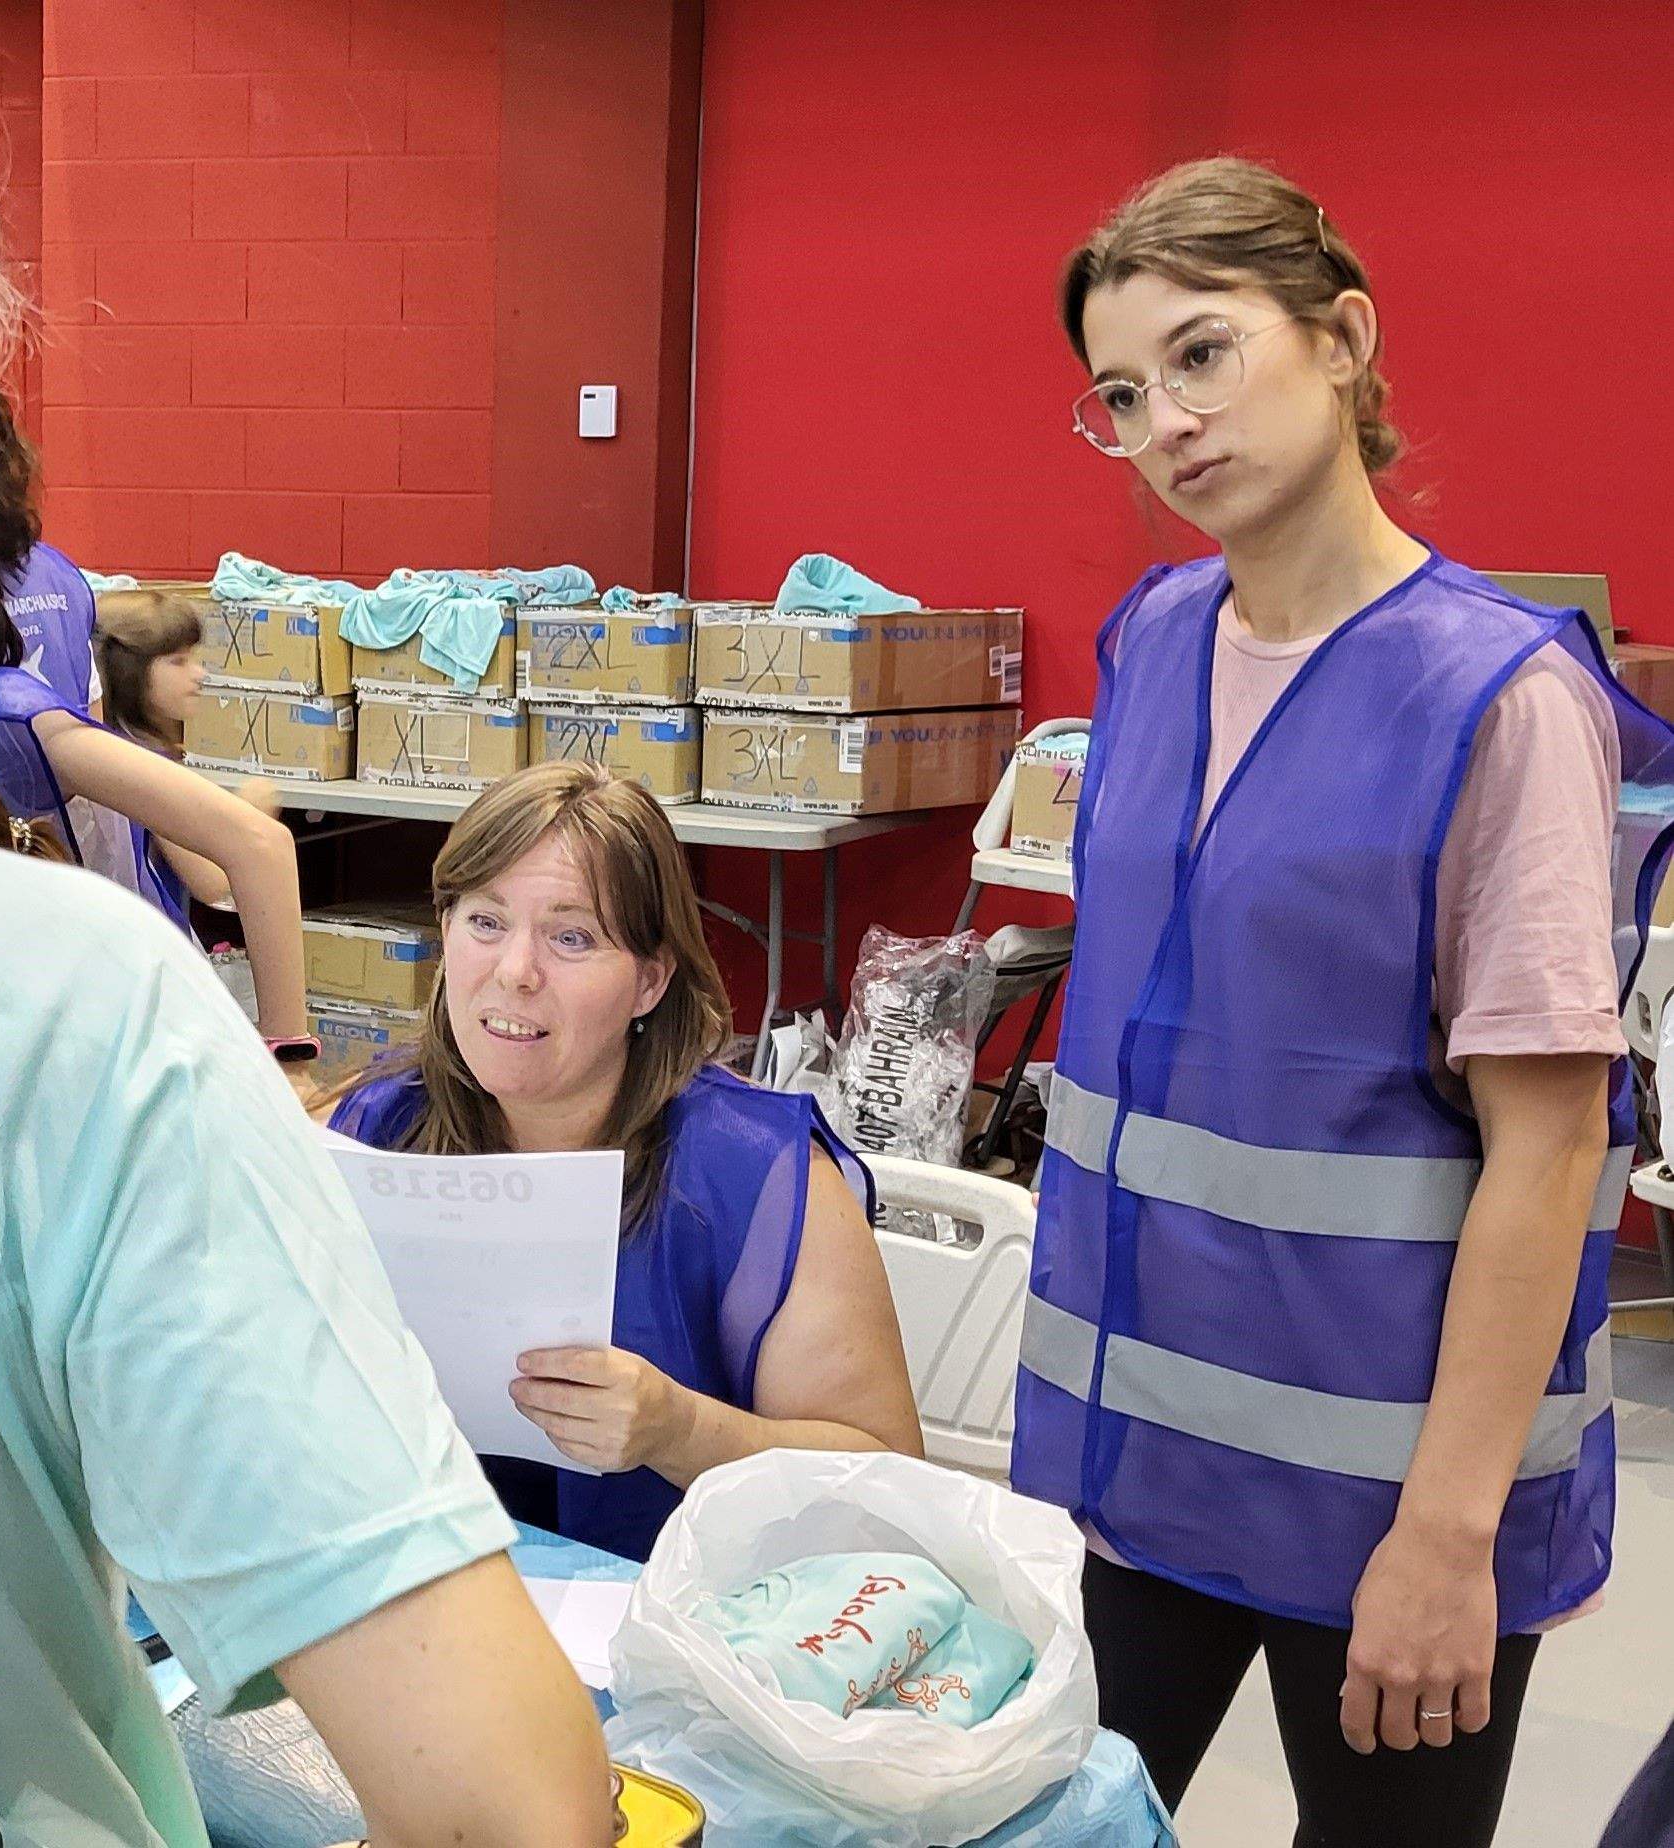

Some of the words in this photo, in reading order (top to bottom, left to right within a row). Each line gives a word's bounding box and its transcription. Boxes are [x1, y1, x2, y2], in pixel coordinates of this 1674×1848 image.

[222, 611, 274, 669] XL
[546, 625, 637, 671] 2XL
[723, 624, 821, 695] 3XL
[241, 695, 281, 764] XL
[391, 713, 439, 779] XL
[727, 728, 798, 785] 3XL
